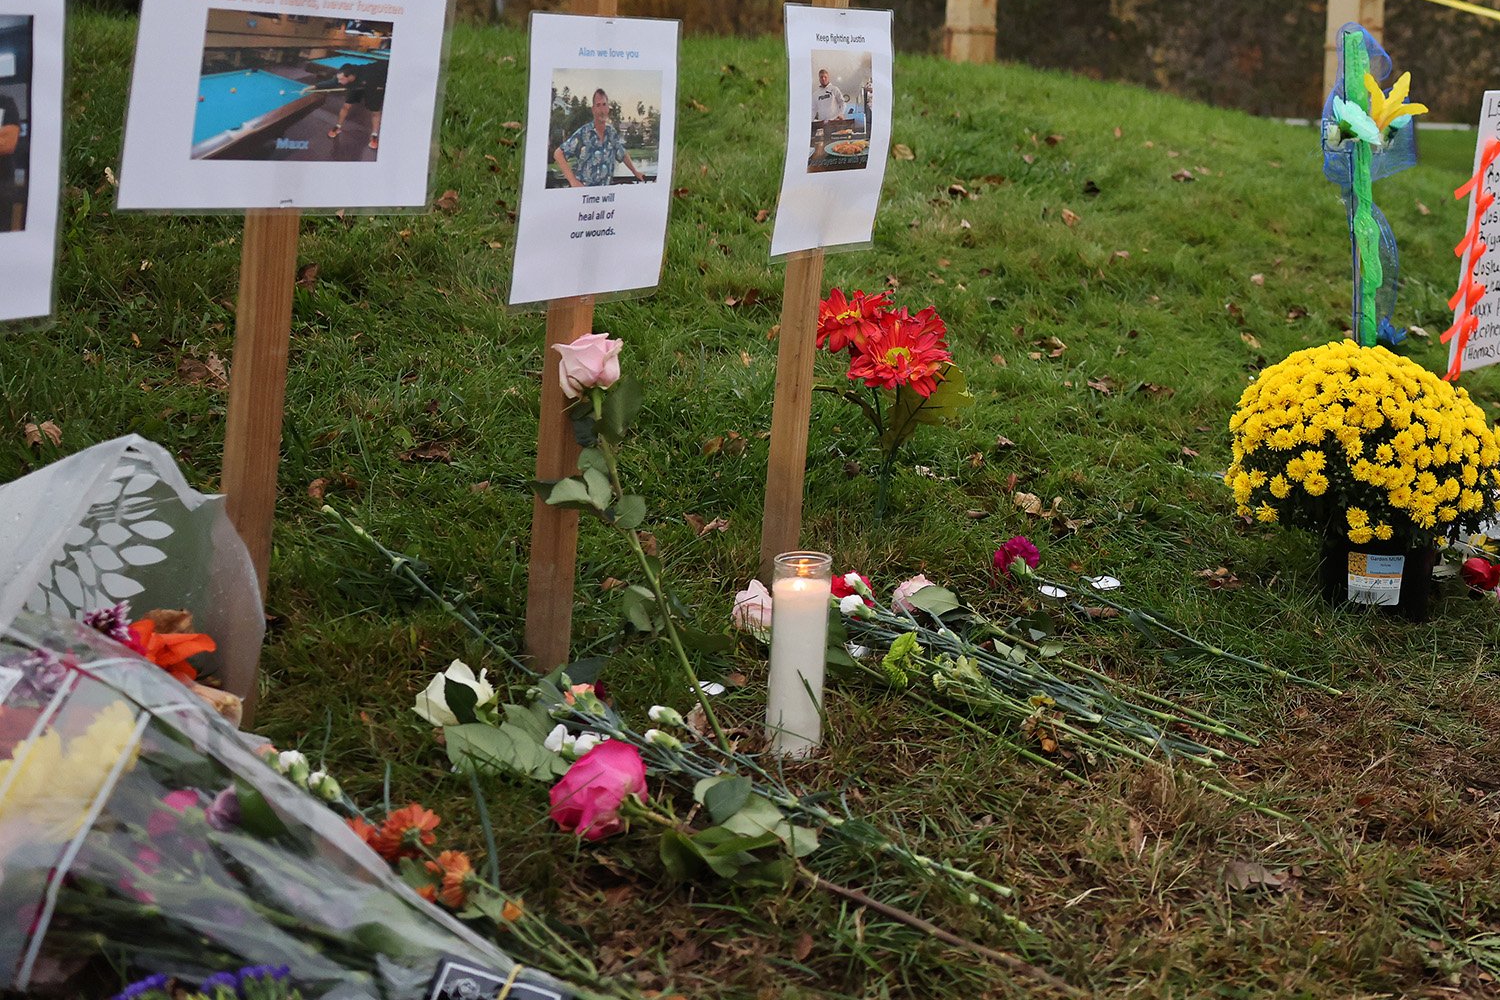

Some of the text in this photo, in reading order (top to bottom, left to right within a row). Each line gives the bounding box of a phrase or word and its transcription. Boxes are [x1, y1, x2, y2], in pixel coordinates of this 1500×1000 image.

[323, 0, 352, 11] never
[357, 0, 404, 16] forgotten
[816, 33, 865, 45] Keep fighting Justin
[578, 47, 639, 60] Alan we love you
[275, 137, 309, 150] Maxx
[582, 193, 615, 204] Time will
[578, 209, 615, 221] heal all of
[570, 226, 616, 239] our wounds.
